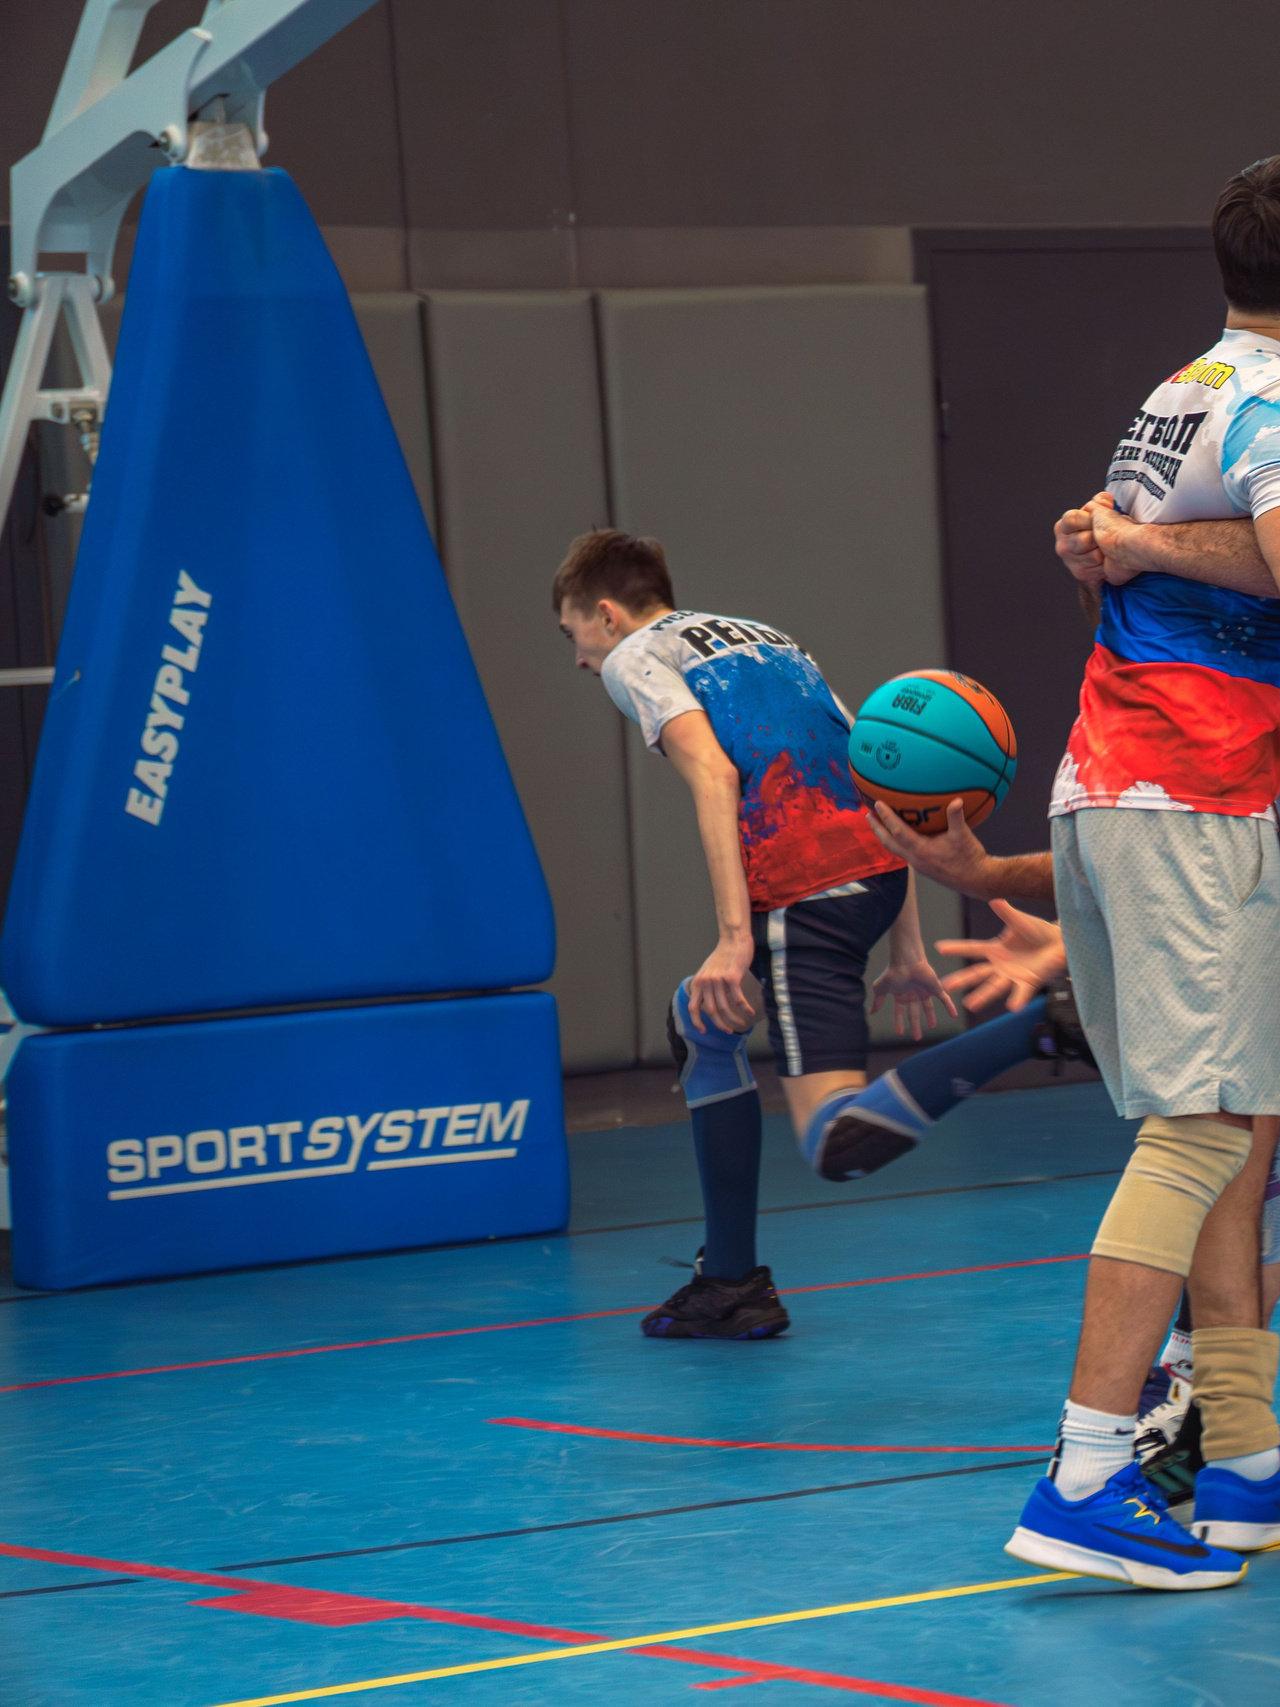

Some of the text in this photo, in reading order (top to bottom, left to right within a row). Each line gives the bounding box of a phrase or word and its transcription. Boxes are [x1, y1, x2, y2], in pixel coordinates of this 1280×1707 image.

[680, 618, 800, 659] РЕГБ
[124, 570, 212, 826] EASYPLAY
[891, 694, 927, 716] FIBA
